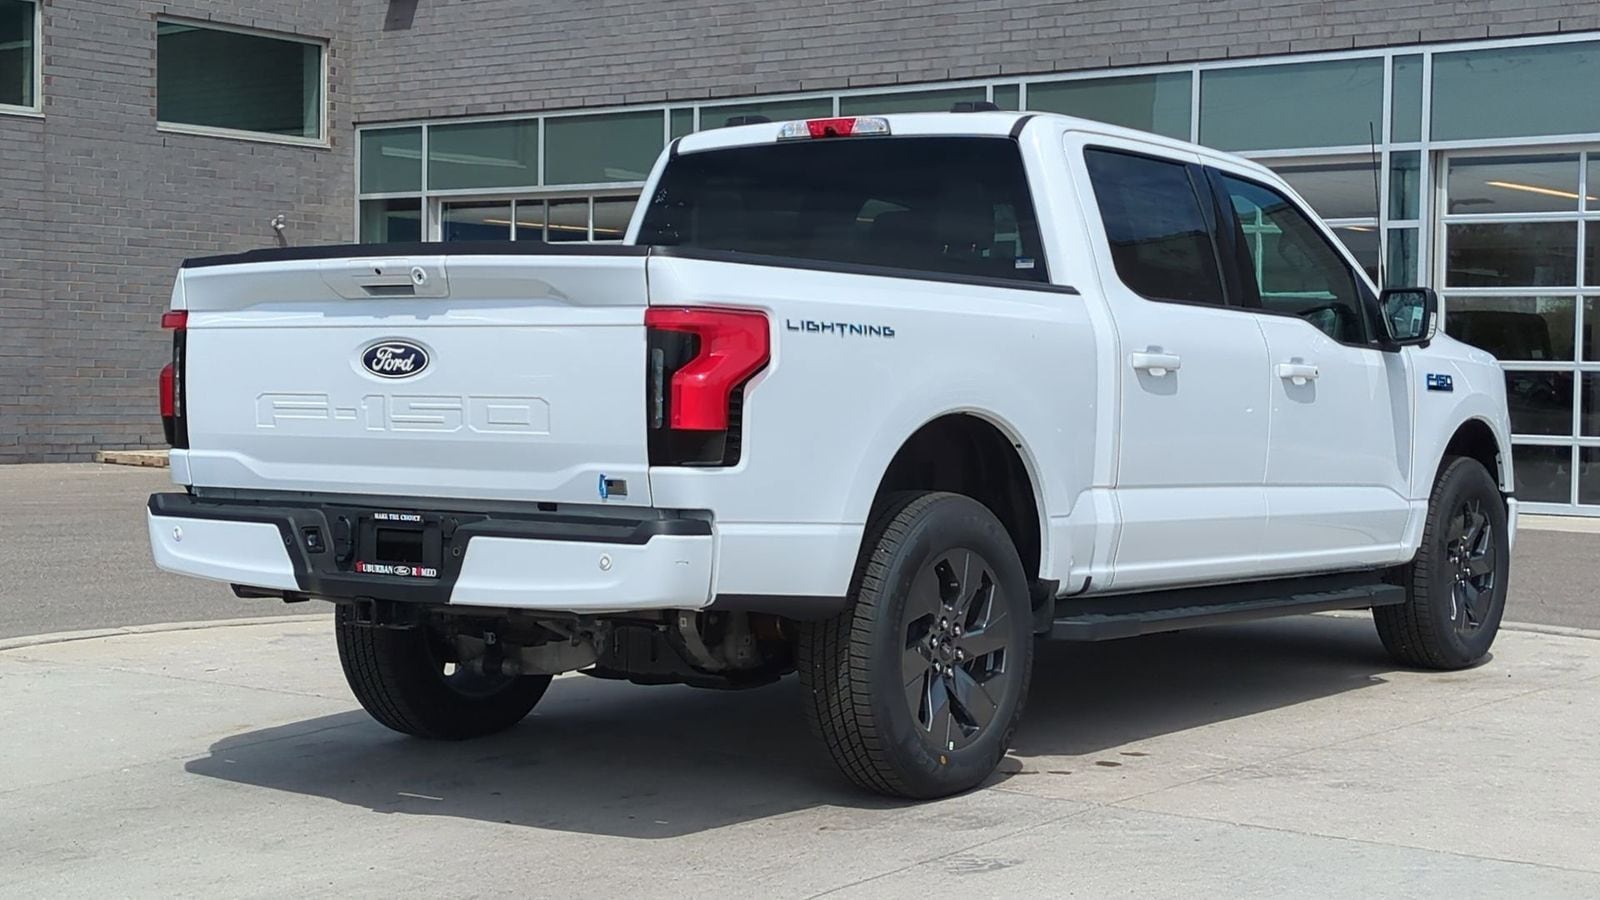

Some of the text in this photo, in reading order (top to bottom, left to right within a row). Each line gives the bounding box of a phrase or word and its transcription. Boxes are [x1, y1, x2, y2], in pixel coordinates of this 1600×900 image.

[786, 318, 896, 338] LIGHTNING
[372, 346, 416, 372] Ford
[255, 392, 550, 436] F-150
[389, 513, 400, 521] THE
[355, 560, 394, 575] SUBURBAN
